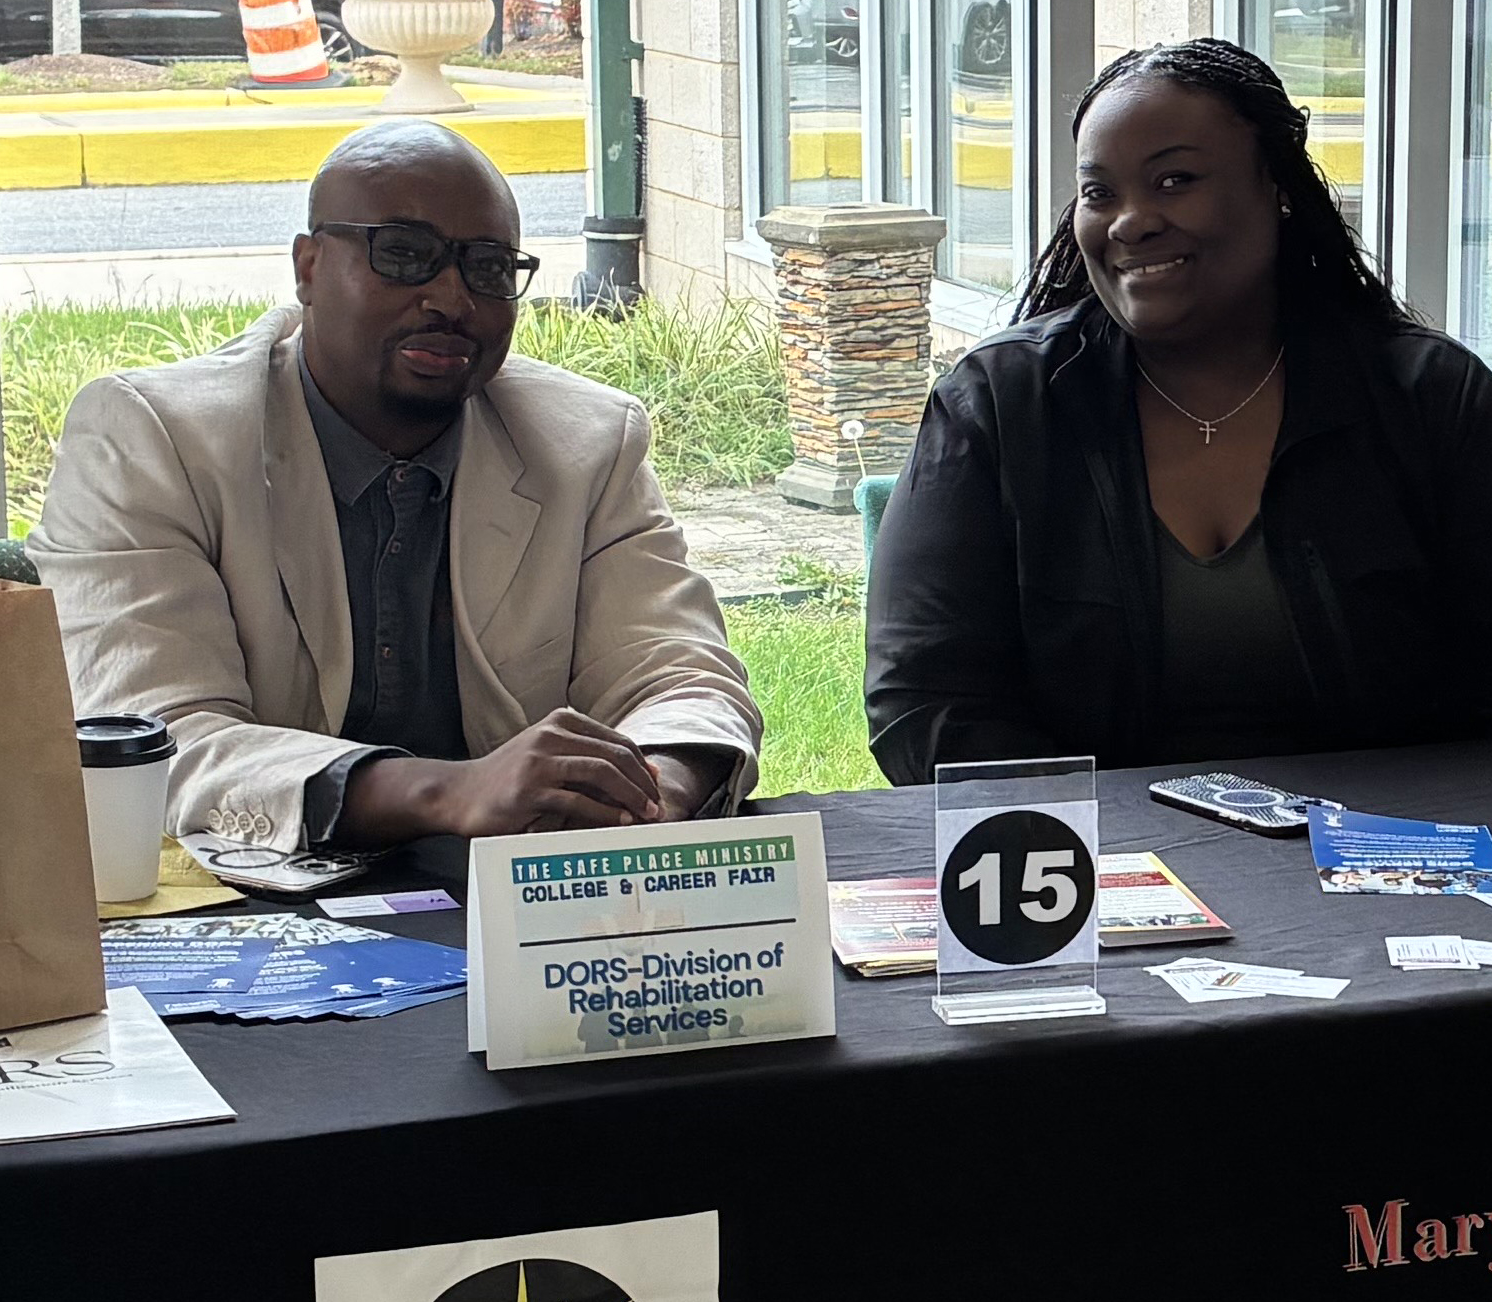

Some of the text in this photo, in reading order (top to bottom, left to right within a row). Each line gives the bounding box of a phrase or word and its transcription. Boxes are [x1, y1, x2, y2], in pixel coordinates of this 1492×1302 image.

[516, 843, 788, 881] THE SAFE PLACE MINISTRY
[522, 866, 775, 904] COLLEGE & CAREER FAIR
[958, 849, 1078, 926] 15
[757, 942, 784, 968] of
[569, 974, 763, 1014] Rehabilitation
[608, 1006, 728, 1038] Services
